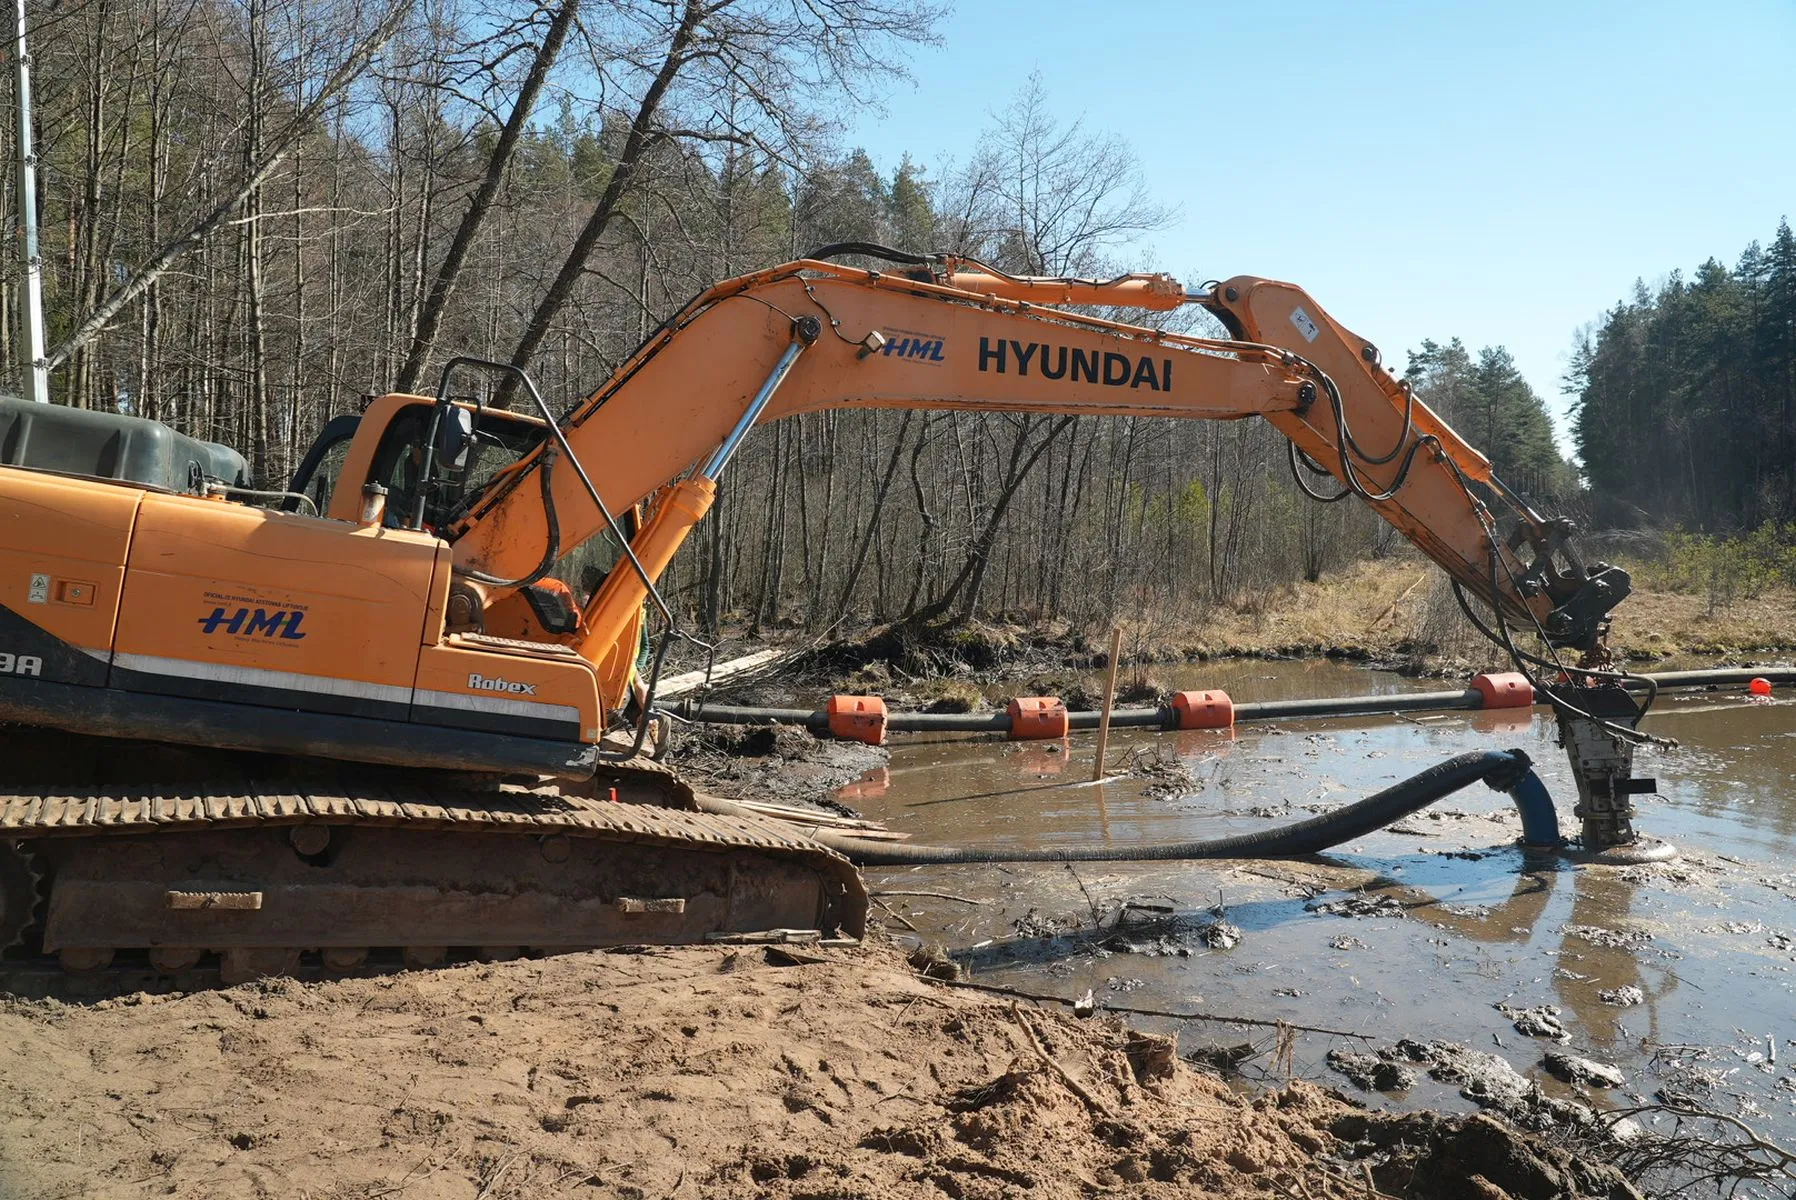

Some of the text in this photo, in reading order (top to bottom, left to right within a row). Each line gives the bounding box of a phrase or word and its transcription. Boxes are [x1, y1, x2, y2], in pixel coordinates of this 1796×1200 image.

[882, 338, 945, 361] HML
[978, 337, 1172, 391] HYUNDAI
[198, 608, 306, 639] HML
[468, 673, 536, 695] Robex
